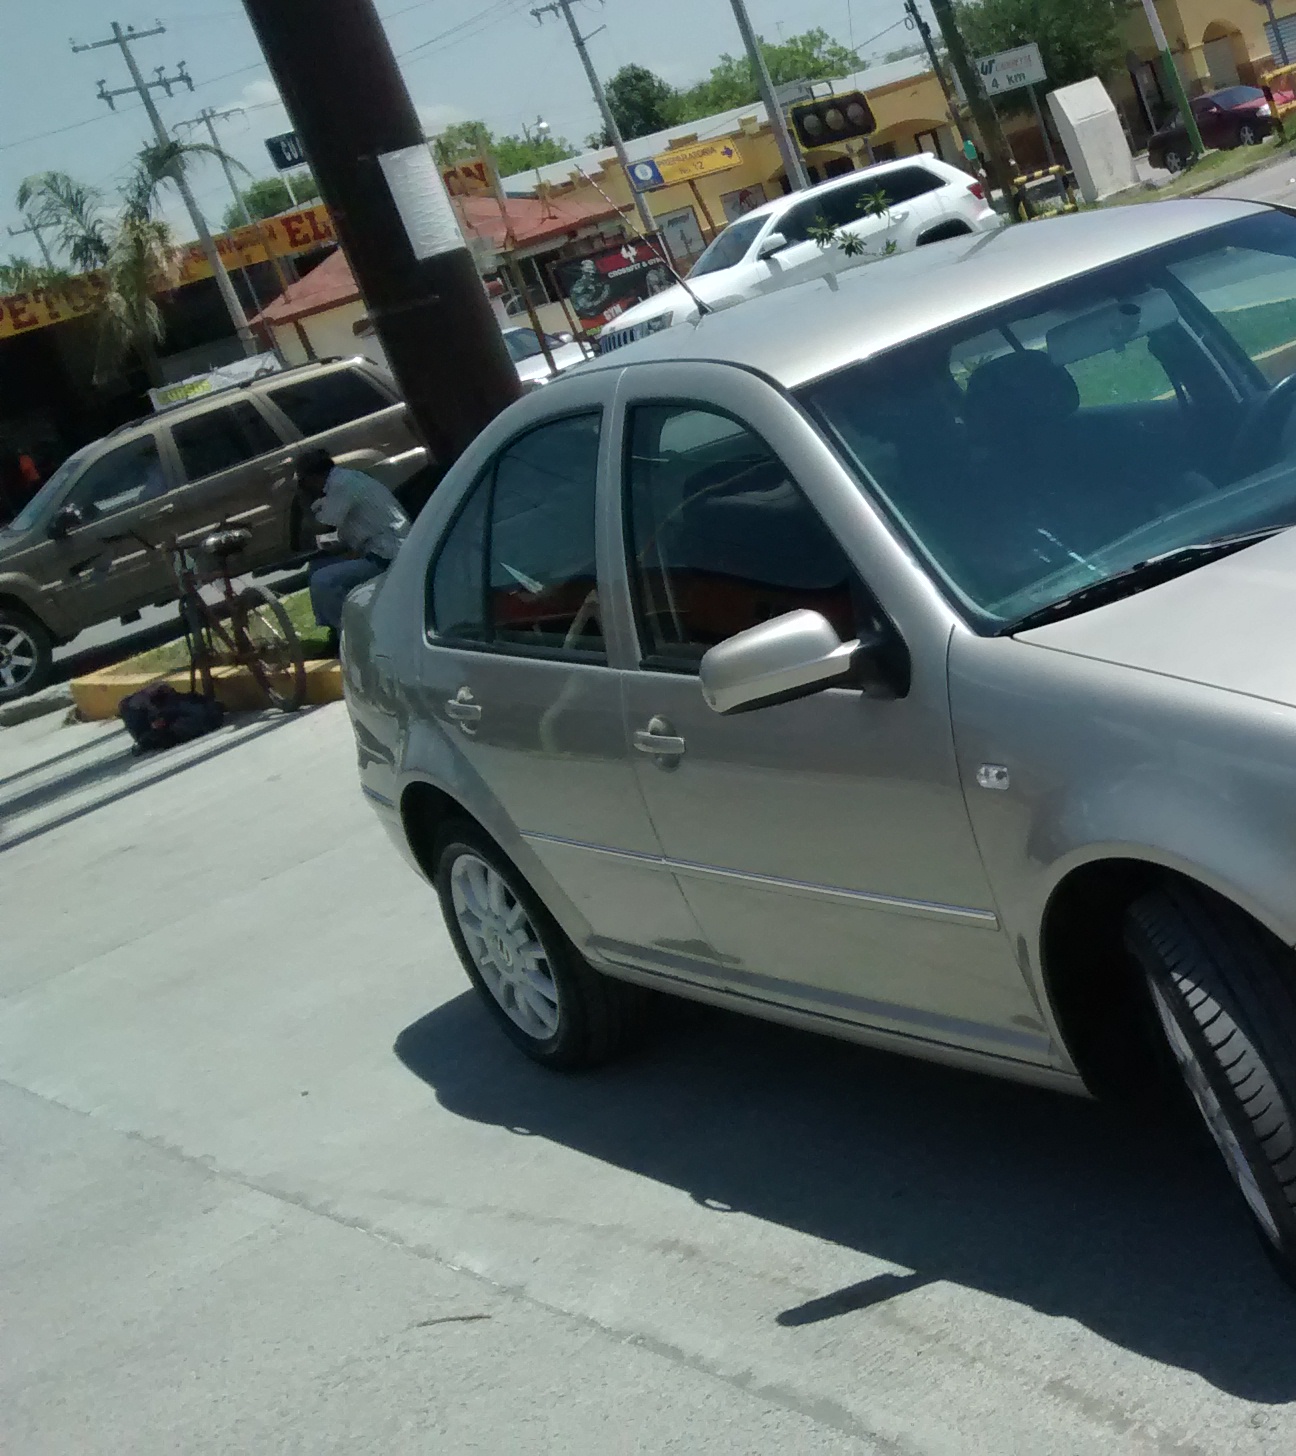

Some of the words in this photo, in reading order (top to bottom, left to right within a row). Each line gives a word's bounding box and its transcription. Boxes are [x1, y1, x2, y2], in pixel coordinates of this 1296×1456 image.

[991, 77, 1000, 89] 4
[1006, 73, 1026, 85] km
[281, 210, 332, 247] EL
